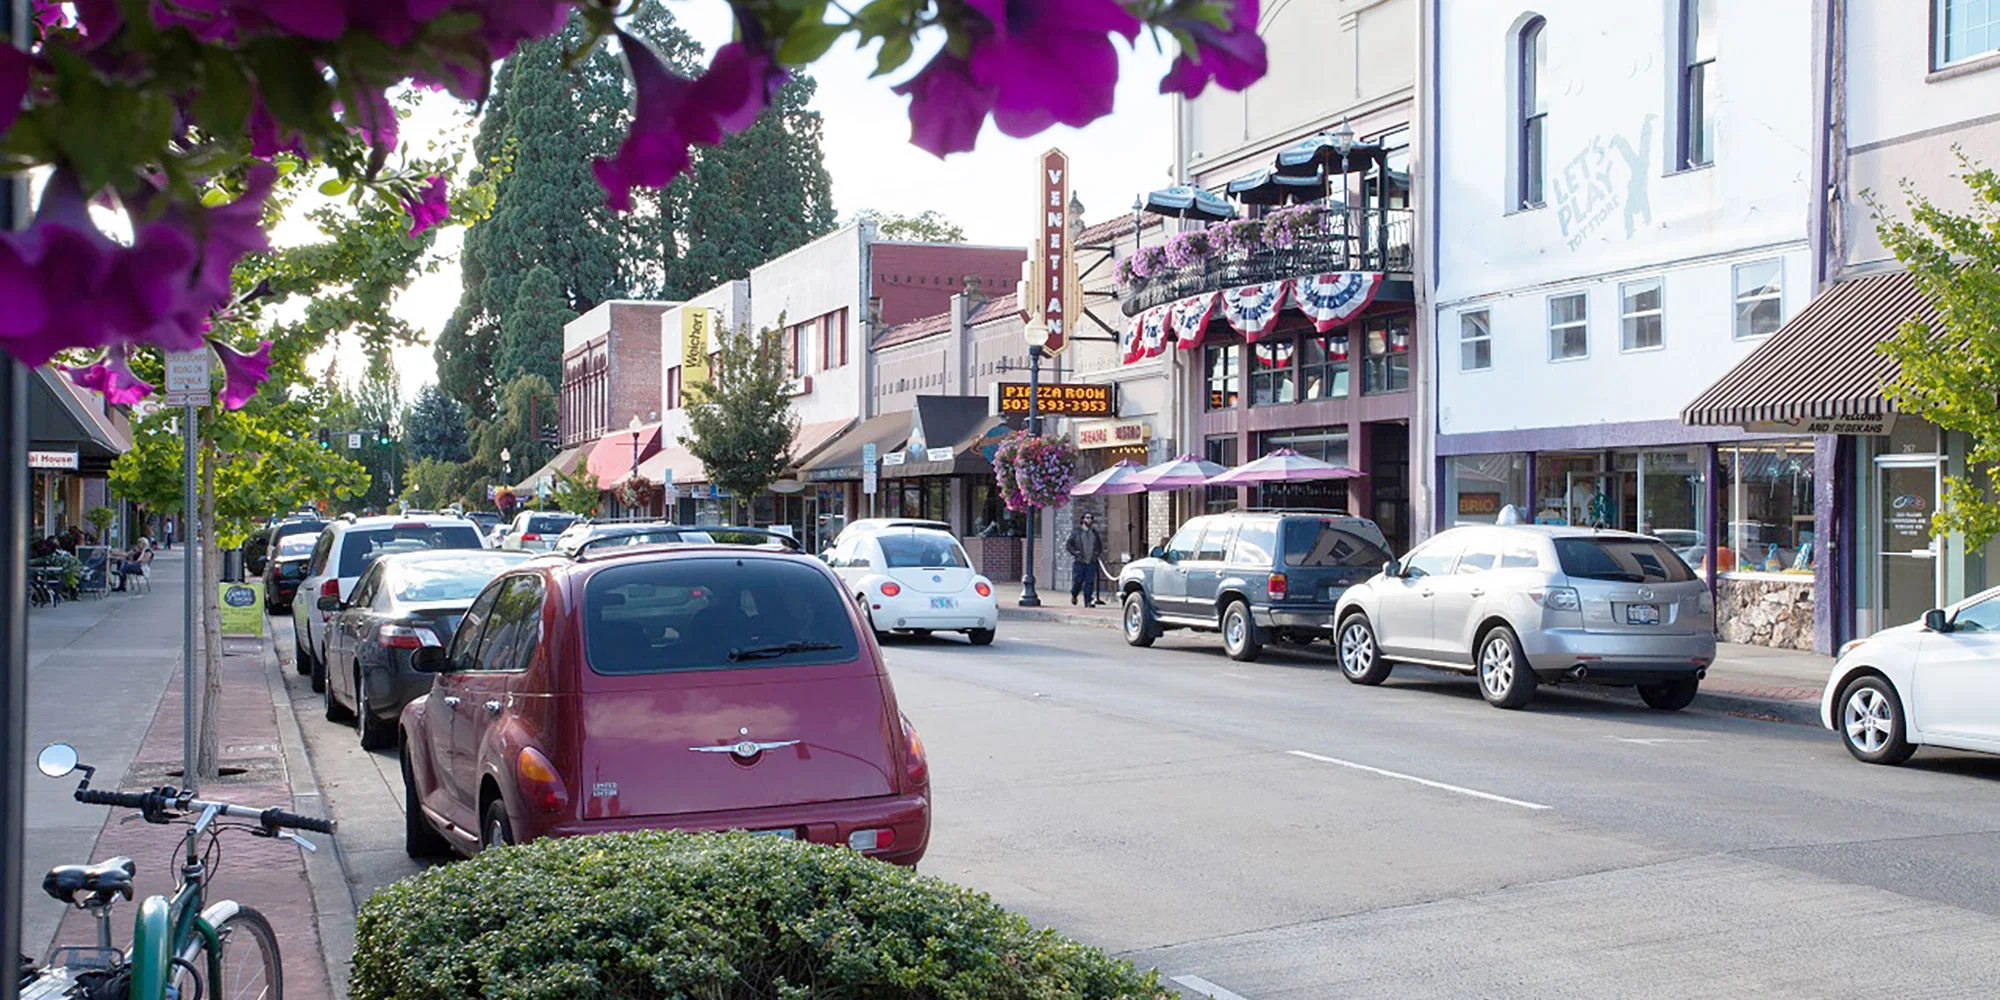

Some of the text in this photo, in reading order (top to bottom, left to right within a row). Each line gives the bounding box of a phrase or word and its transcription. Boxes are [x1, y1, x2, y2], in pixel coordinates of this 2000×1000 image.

[1552, 134, 1605, 205] LET'S
[1558, 160, 1613, 236] PLAY
[1567, 194, 1620, 252] TOY STORE
[1047, 169, 1063, 334] VENETIAN
[1005, 387, 1106, 399] PIAZZA ROOM
[1808, 423, 1884, 433] AND REBEKAHS
[41, 455, 72, 463] House
[1460, 499, 1494, 512] BRIO
